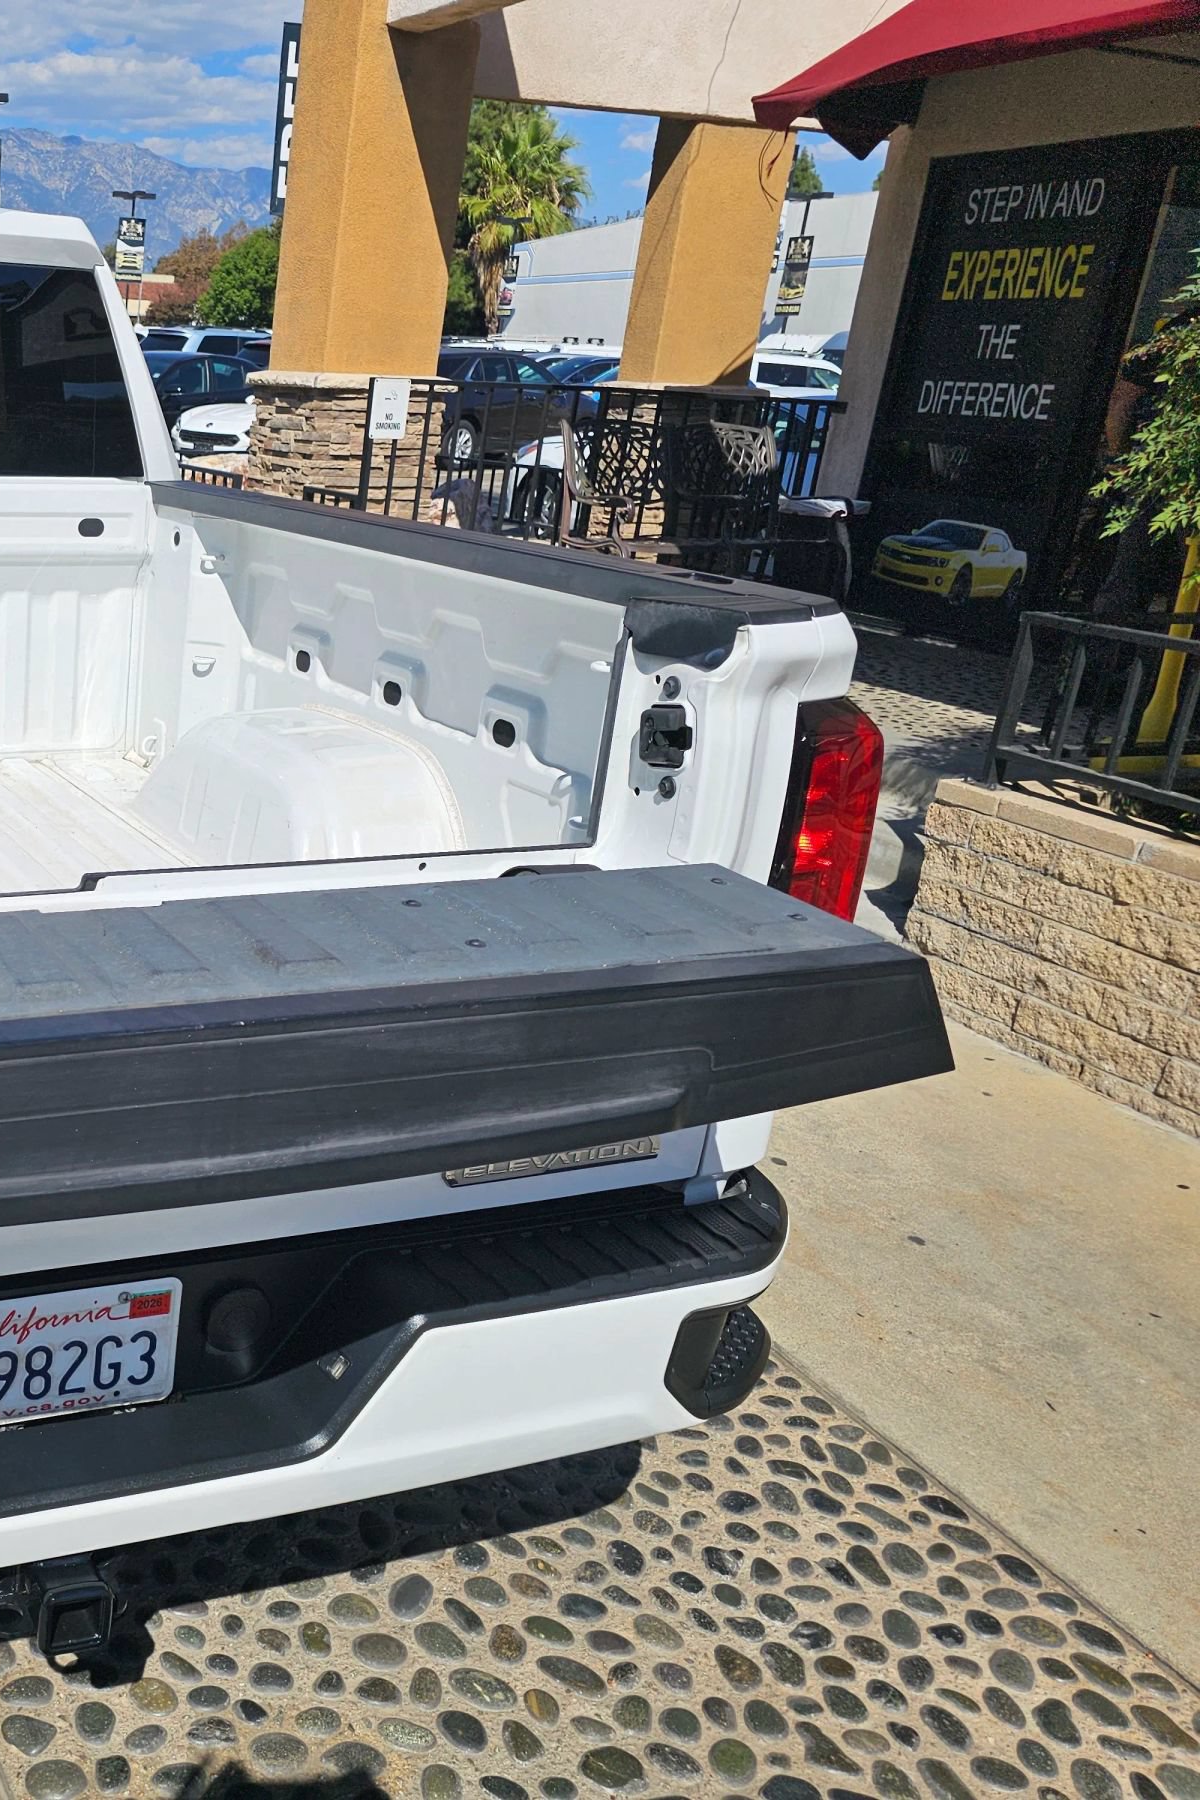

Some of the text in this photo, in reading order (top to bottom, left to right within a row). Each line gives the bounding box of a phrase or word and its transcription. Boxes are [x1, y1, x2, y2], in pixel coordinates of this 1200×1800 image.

[964, 177, 1105, 225] STEP IN AND
[941, 244, 1096, 301] EXPERIENCE
[976, 324, 1021, 360] THE
[385, 413, 393, 421] NO
[917, 380, 1056, 421] DIFFERENCE
[375, 422, 401, 431] SMOKING
[463, 1141, 646, 1179] ELEVATION
[137, 1298, 163, 1310] 2026
